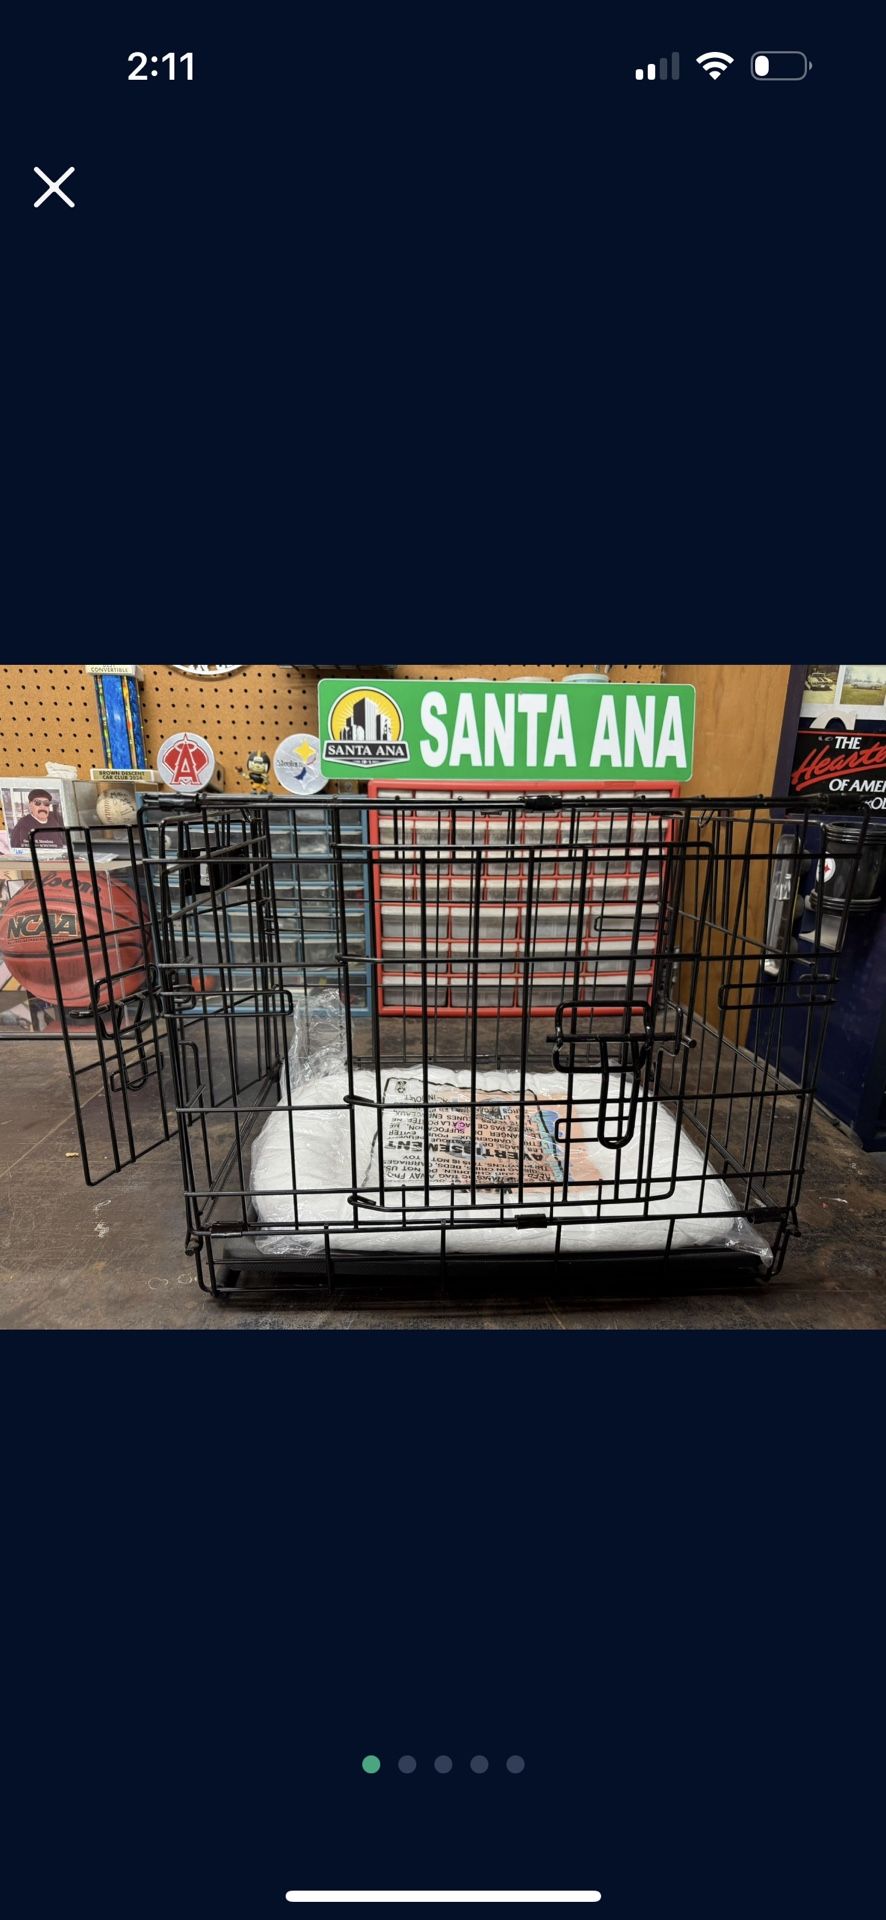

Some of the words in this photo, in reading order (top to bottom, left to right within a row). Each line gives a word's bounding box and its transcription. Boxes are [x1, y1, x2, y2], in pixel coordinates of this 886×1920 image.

[420, 691, 576, 767] SANTA
[590, 695, 687, 768] ANA
[835, 736, 862, 750] THE
[328, 745, 372, 755] SANTA
[376, 745, 405, 756] ANA
[829, 778, 850, 792] OF
